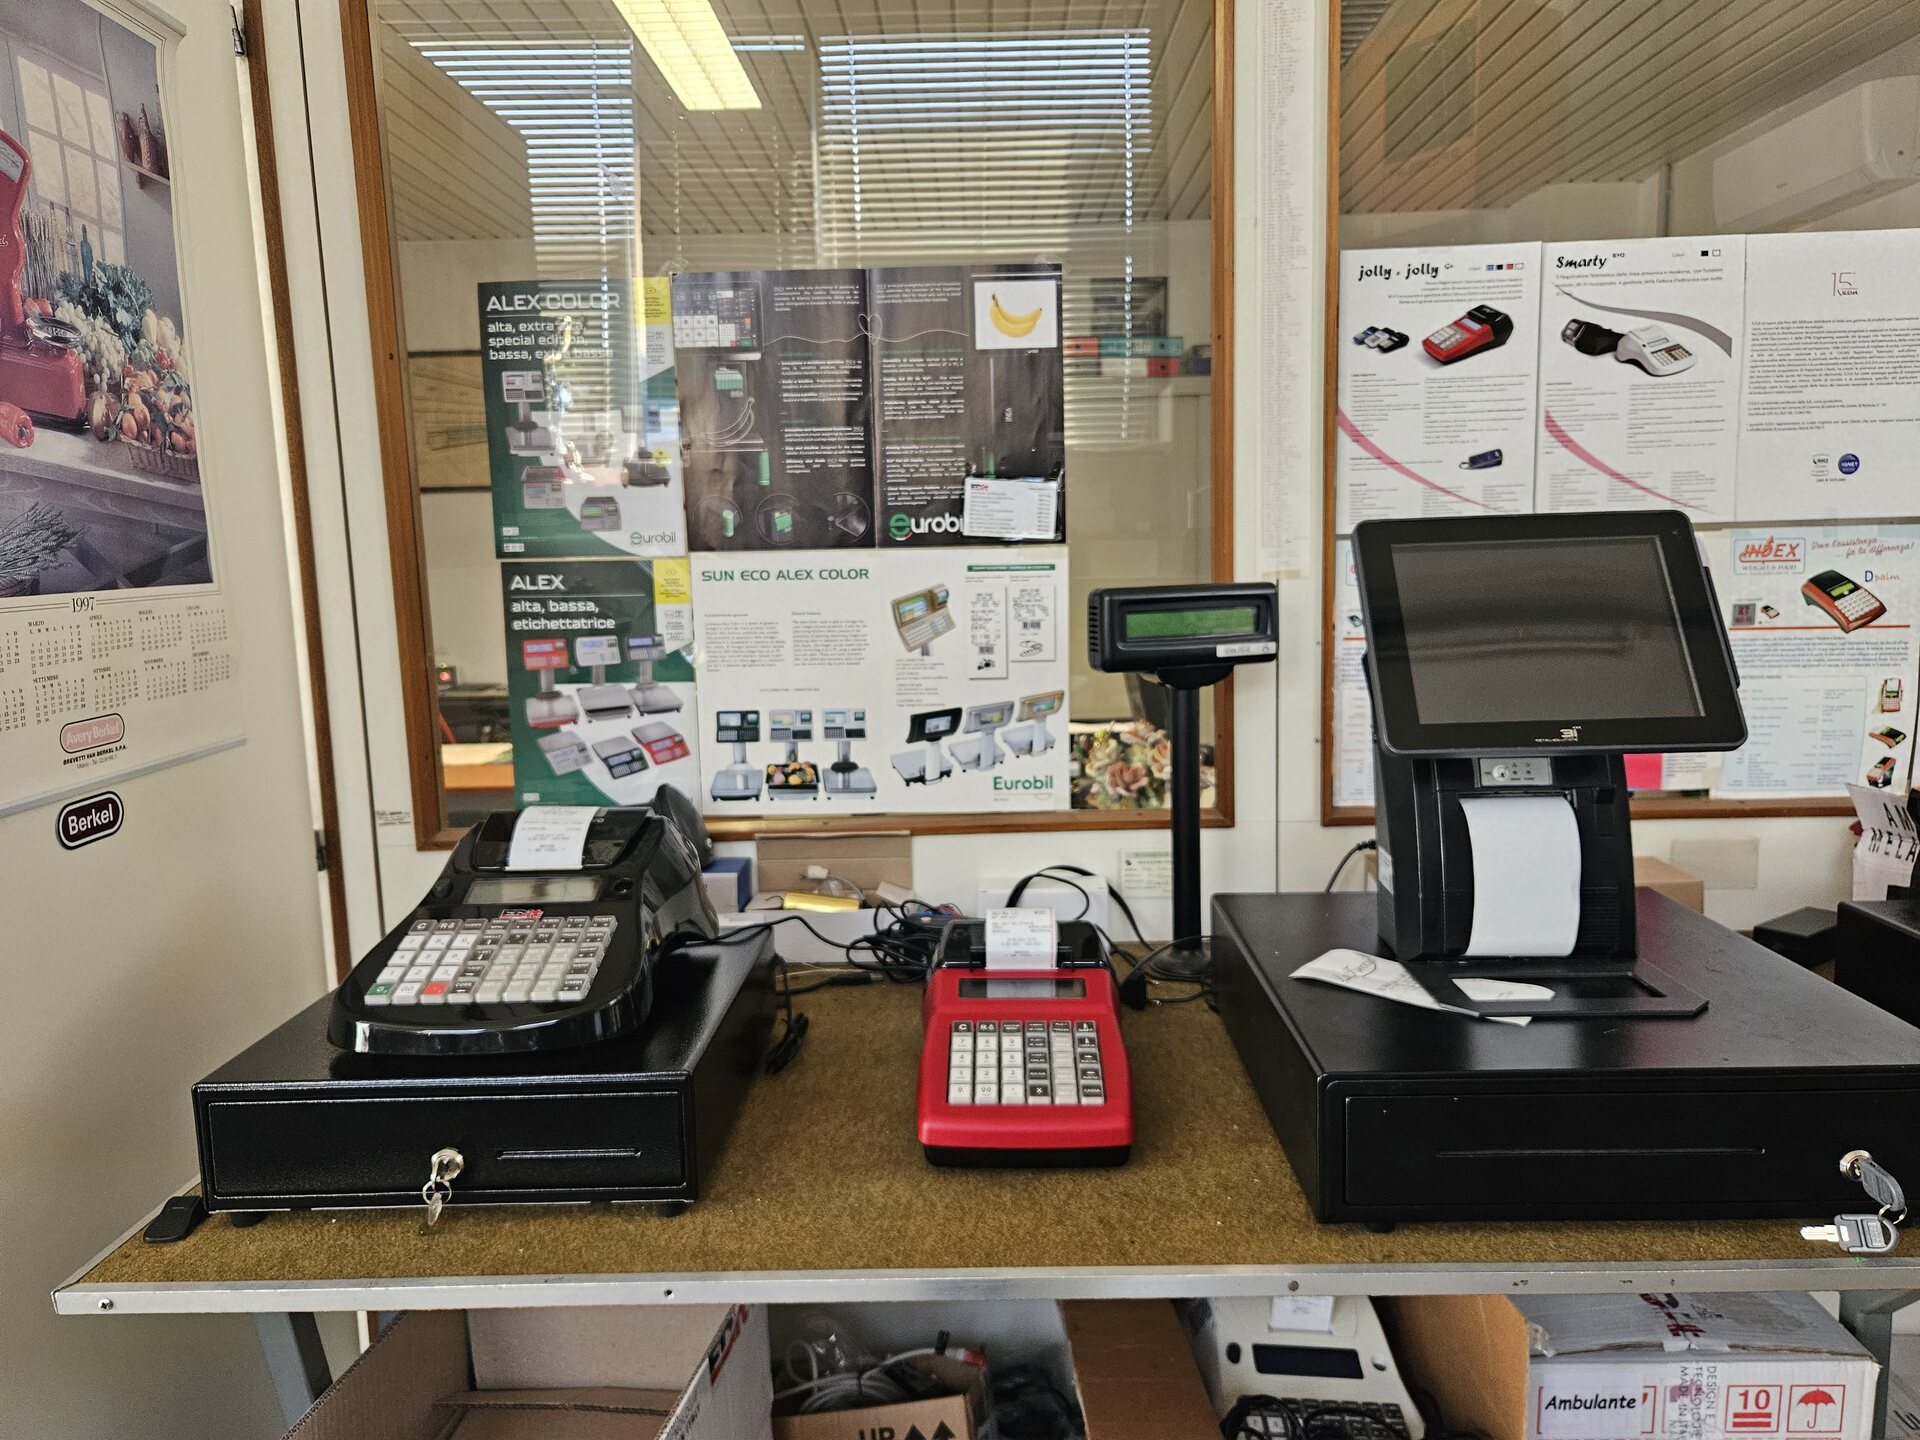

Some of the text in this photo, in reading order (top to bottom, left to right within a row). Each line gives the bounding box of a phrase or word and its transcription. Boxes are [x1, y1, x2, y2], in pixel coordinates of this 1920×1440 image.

[1556, 255, 1607, 269] Smarty
[1358, 264, 1392, 282] jolly
[1405, 263, 1439, 280] jolly
[486, 292, 621, 312] ALEX COLOR
[487, 321, 516, 333] alta,
[518, 321, 553, 332] extra
[488, 333, 535, 348] special
[490, 349, 532, 361] bassa,
[630, 531, 677, 547] eurobil
[1742, 543, 1800, 558] INDEX
[510, 574, 566, 591] ALEX
[701, 568, 870, 582] SUN ECO ALEX COLOR
[71, 597, 95, 613] 1997
[511, 599, 599, 614] alta, bassa,
[513, 617, 616, 631] etichettatrice
[66, 720, 120, 747] Avery Berkel
[992, 775, 1054, 791] Eurobil
[67, 803, 114, 836] Berkel
[1678, 1365, 1689, 1399] MADE
[1706, 1365, 1717, 1409] DESIGN
[1545, 1394, 1637, 1411] Ambulante
[1737, 1389, 1770, 1410] 10
[1678, 1404, 1688, 1417] IN
[858, 1426, 895, 1440] UP
